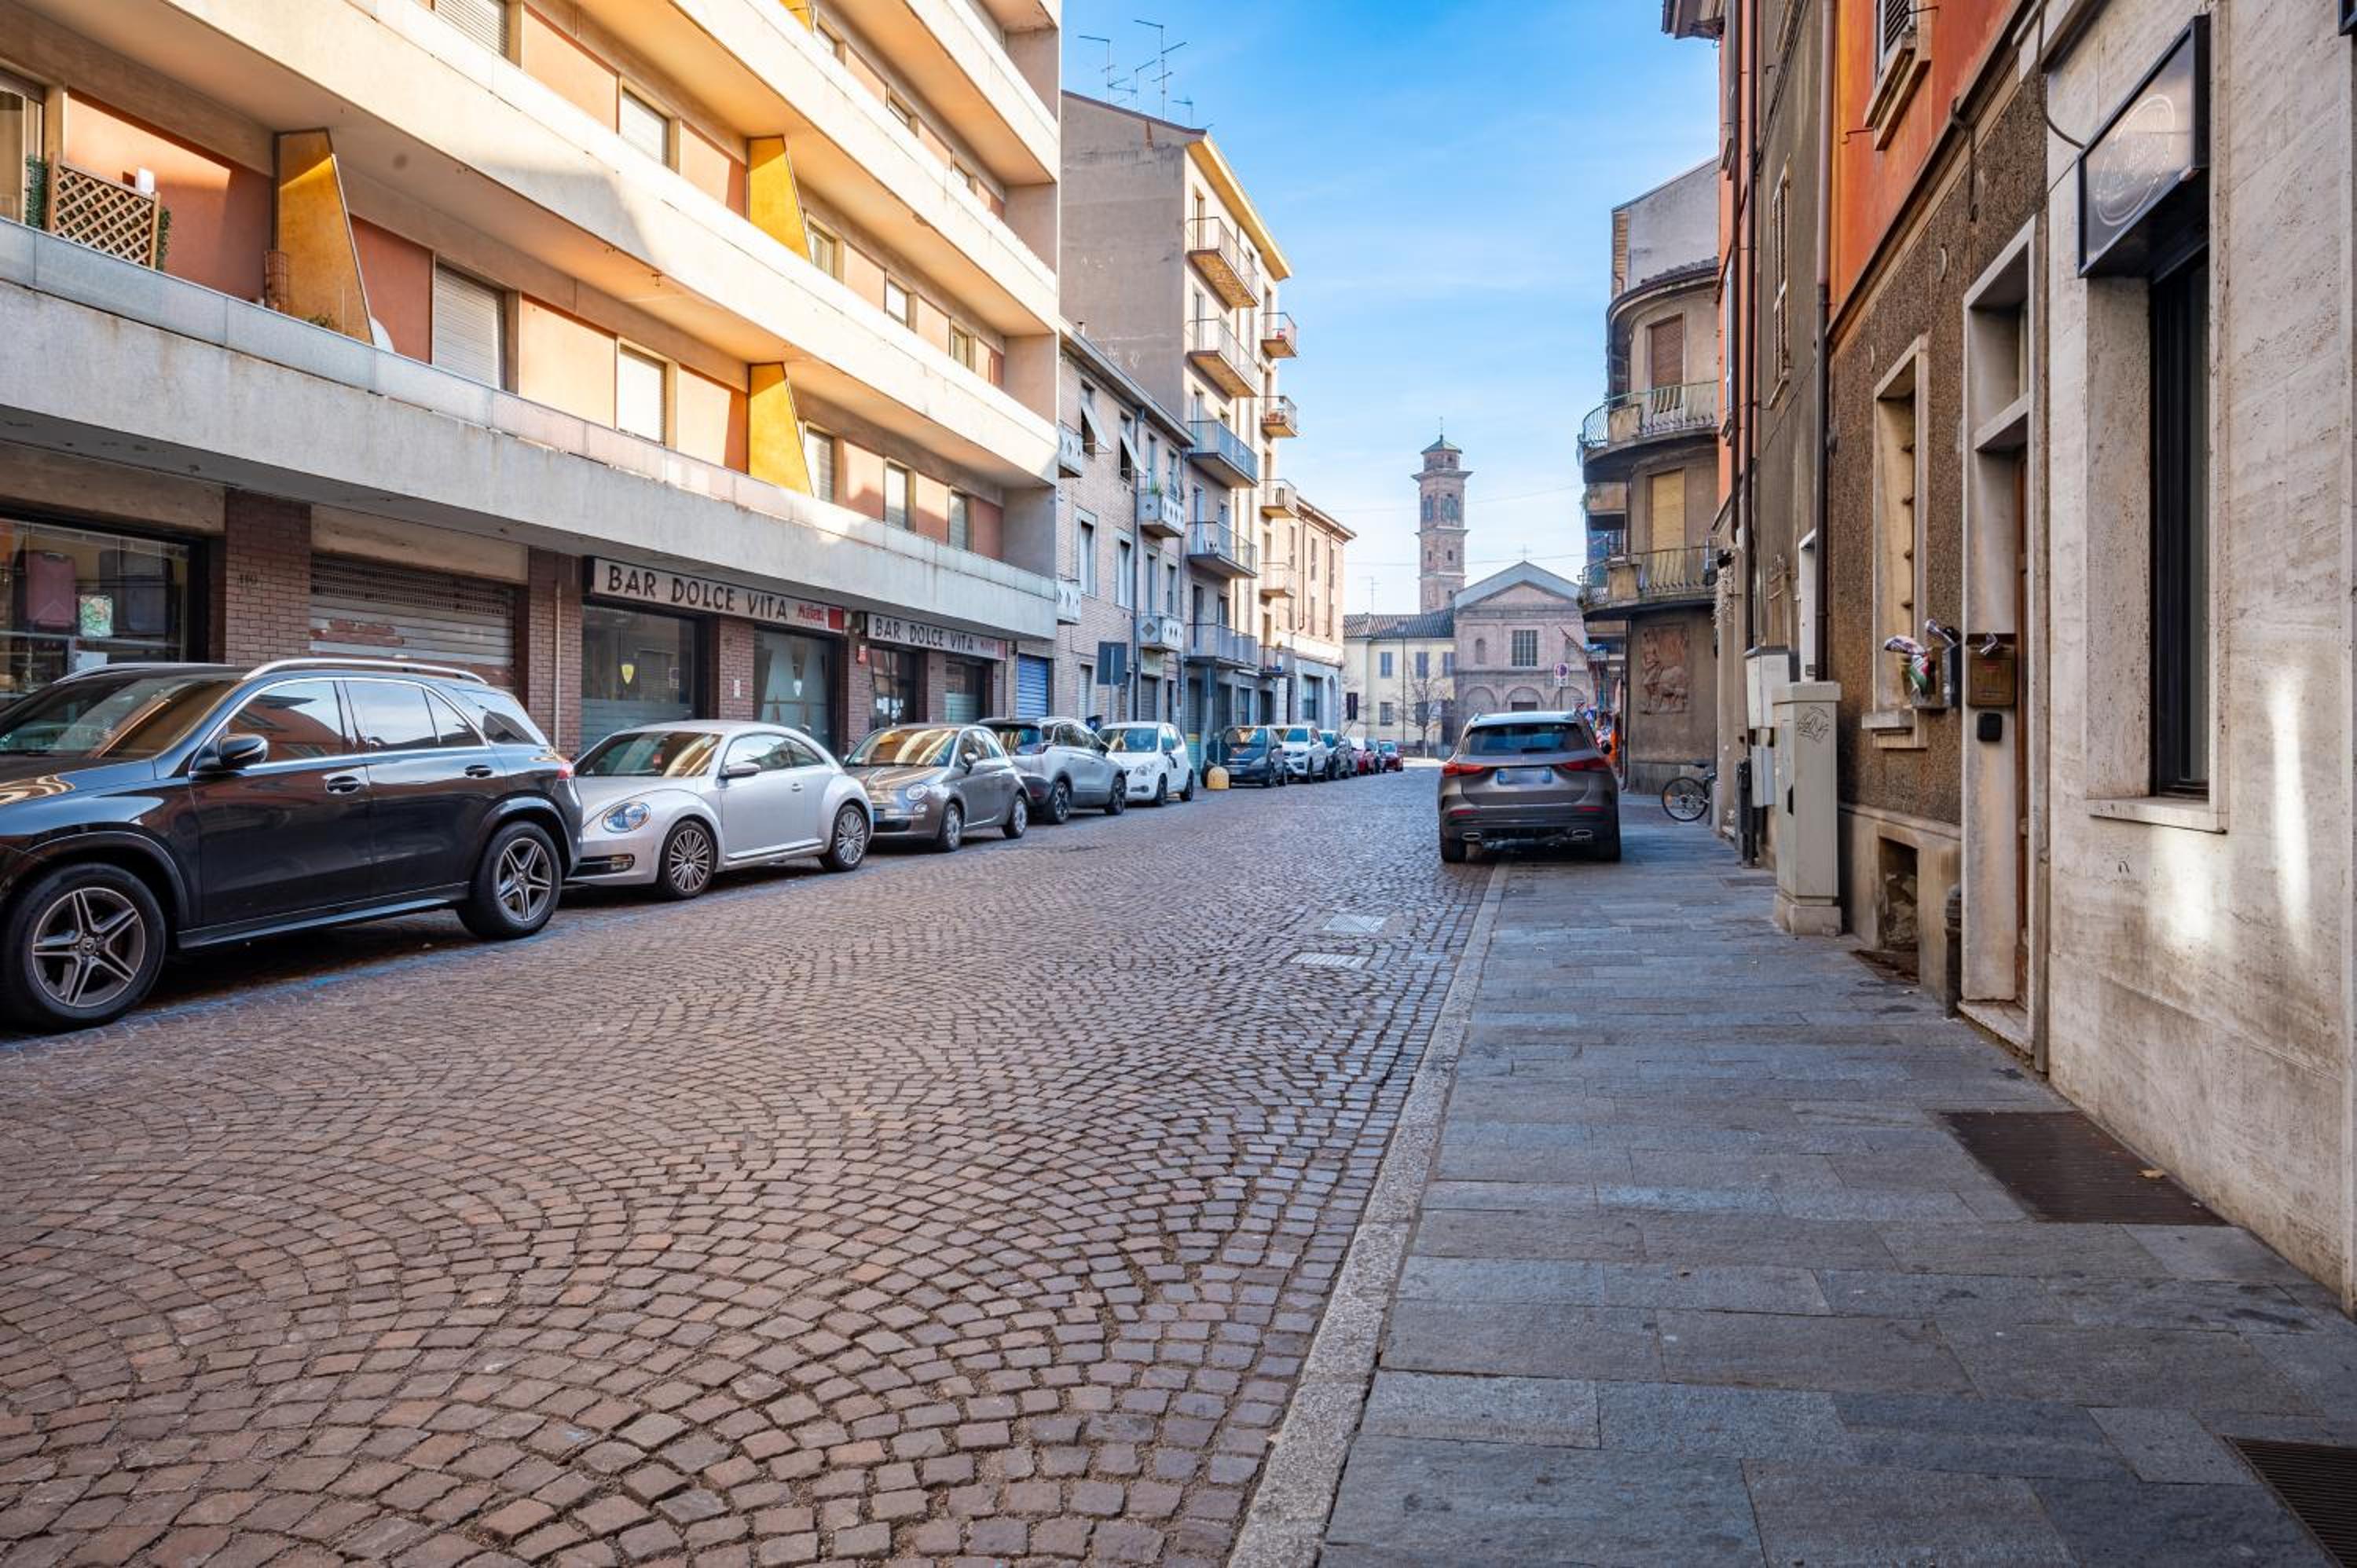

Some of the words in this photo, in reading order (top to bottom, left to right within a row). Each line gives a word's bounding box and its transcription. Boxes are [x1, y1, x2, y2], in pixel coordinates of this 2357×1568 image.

[607, 565, 656, 599] BAR
[670, 577, 735, 611] DOLCE
[747, 591, 788, 620] VITA
[874, 617, 901, 639] BAR
[909, 625, 944, 647] DOLCE
[949, 632, 973, 650] VITA
